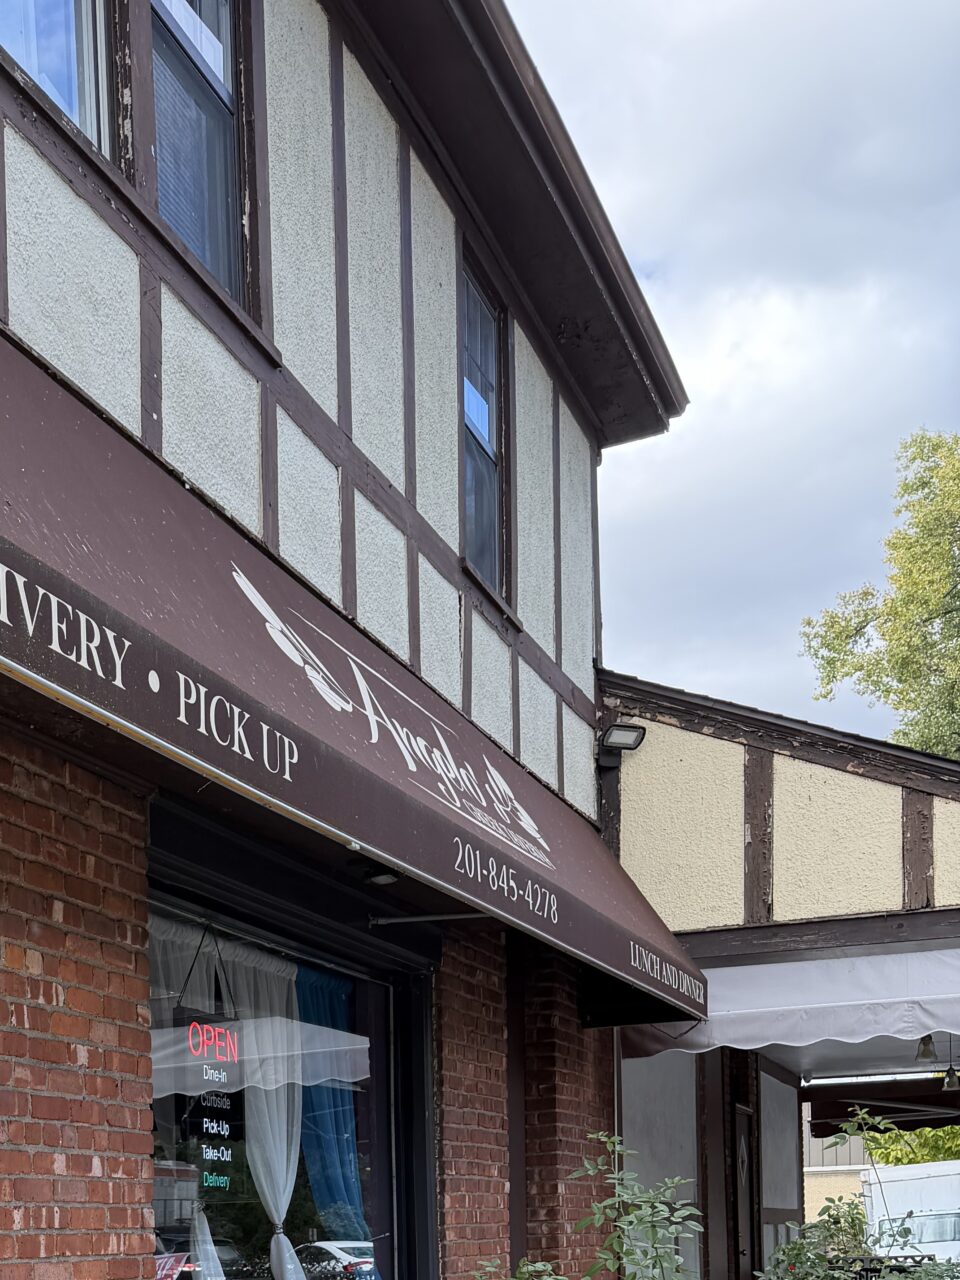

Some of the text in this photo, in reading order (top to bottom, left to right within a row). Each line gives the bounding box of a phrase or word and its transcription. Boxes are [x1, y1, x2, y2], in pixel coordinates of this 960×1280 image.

[175, 670, 255, 763] PICK
[260, 721, 300, 783] UP
[347, 656, 512, 825] Angelo's
[453, 836, 559, 924] 201-845-4278
[630, 941, 705, 1005] LUNCH AND DINNER
[188, 1021, 238, 1064] OPEN
[203, 1065, 228, 1083] Dine-In
[200, 1092, 231, 1110] Curbside
[203, 1117, 230, 1139] Pick-Up
[201, 1144, 232, 1162] Take-Out
[203, 1171, 231, 1191] Delivery
